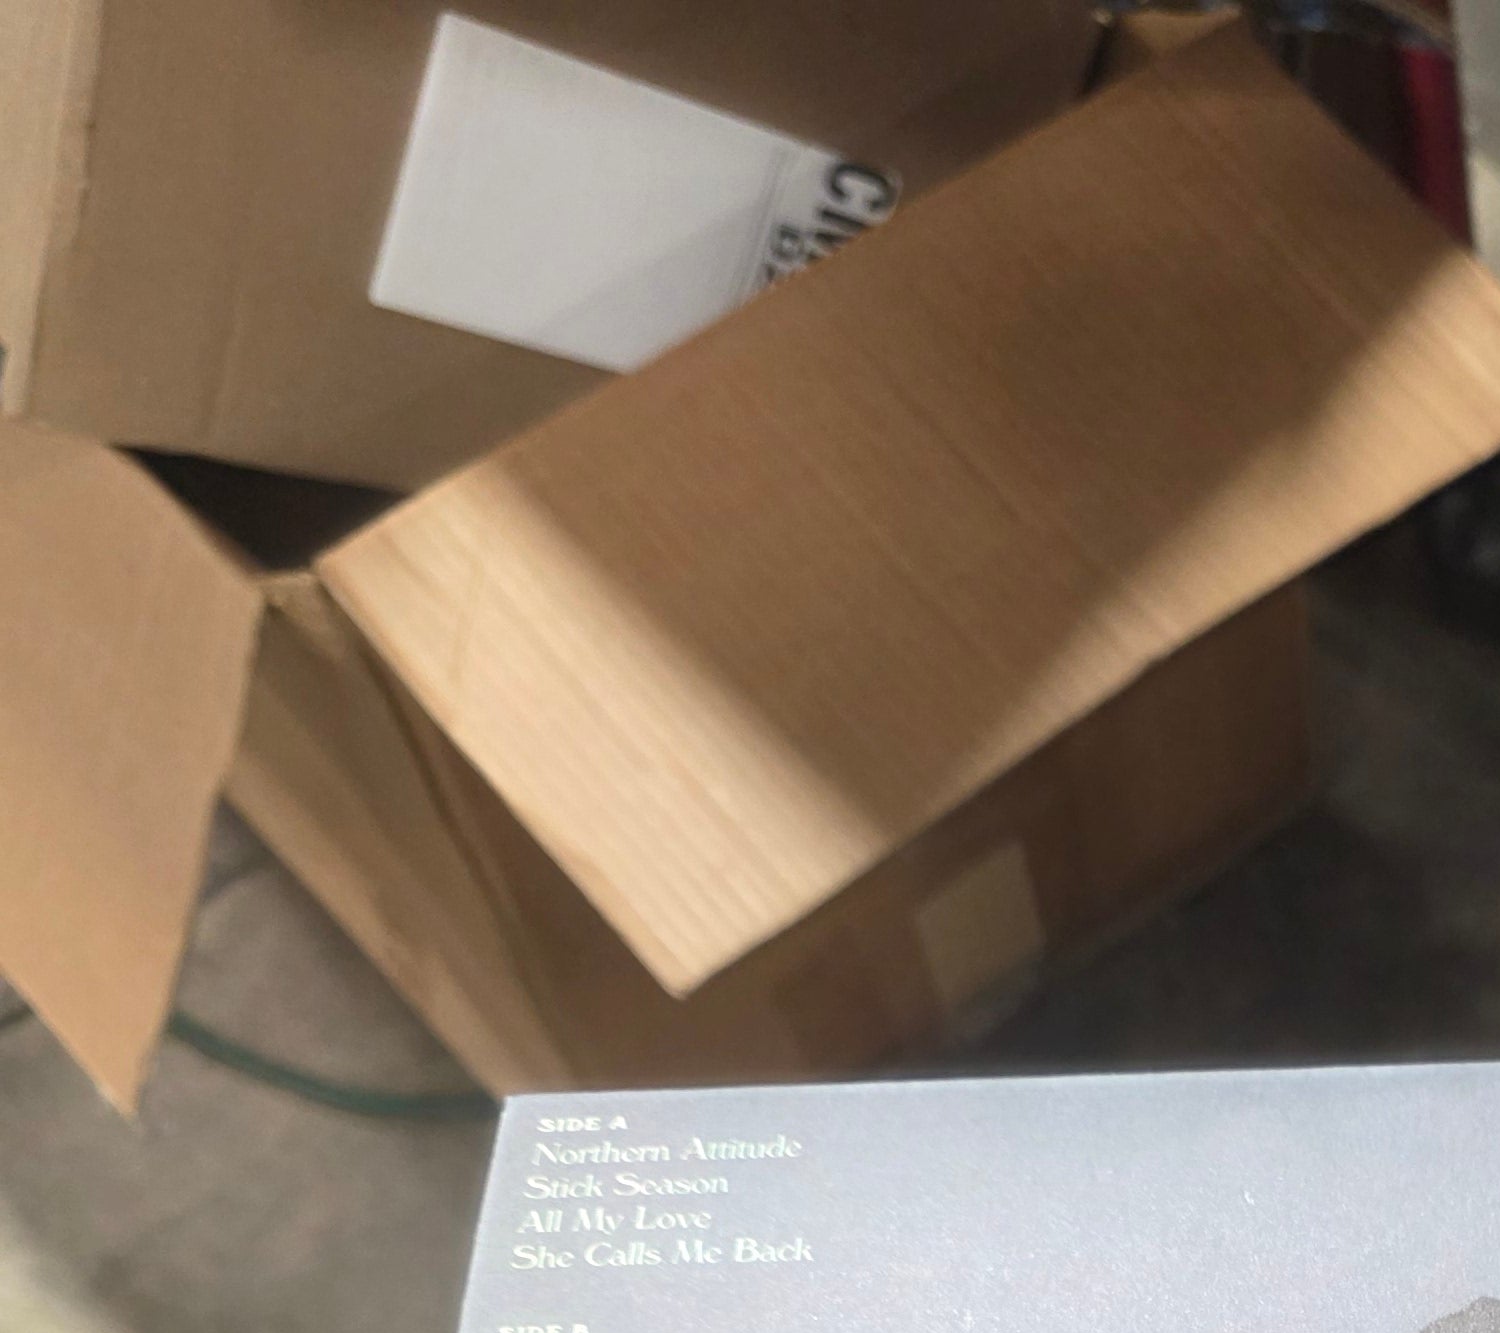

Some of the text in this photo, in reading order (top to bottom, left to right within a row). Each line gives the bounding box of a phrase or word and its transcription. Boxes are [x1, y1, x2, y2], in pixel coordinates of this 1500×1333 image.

[537, 1116, 628, 1133] SIDE A
[532, 1135, 803, 1167] Northern Attitude
[523, 1173, 729, 1200] Stick Season
[516, 1206, 712, 1235] All My Love
[510, 1237, 814, 1270] She Calls Me Back
